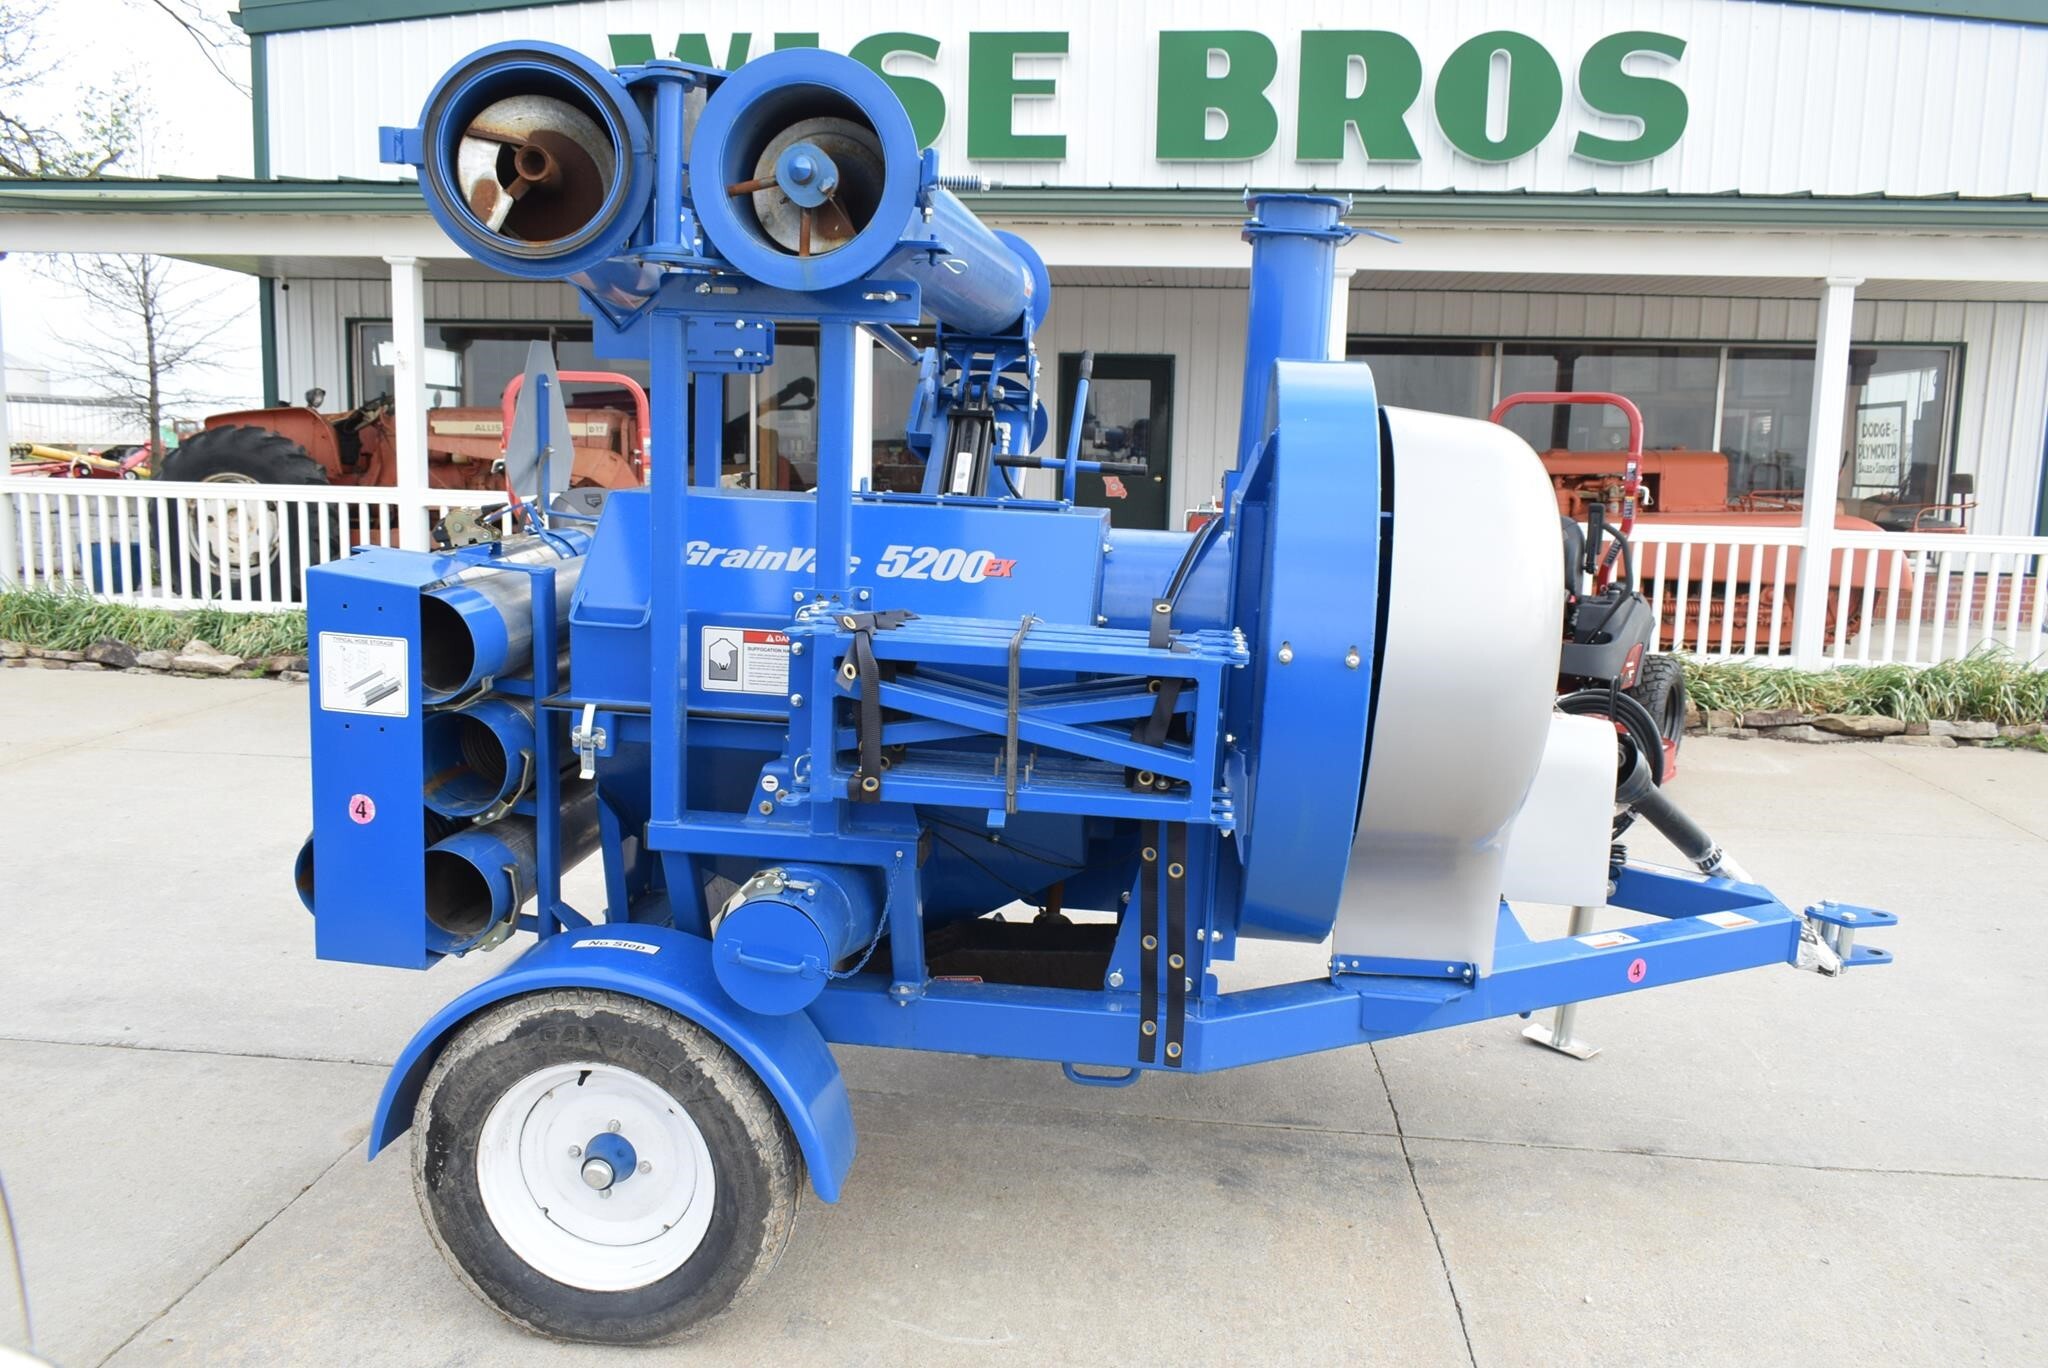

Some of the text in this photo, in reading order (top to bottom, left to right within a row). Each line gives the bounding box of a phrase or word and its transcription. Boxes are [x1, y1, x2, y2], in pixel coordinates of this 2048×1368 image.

[607, 30, 1690, 166] SE BROS
[474, 423, 502, 432] ALLIS
[1857, 443, 1897, 460] PLYMOUTH
[875, 544, 996, 583] 5200
[983, 558, 1017, 577] EX
[355, 800, 367, 819] 4
[612, 941, 646, 951] Step
[1633, 963, 1641, 977] 4
